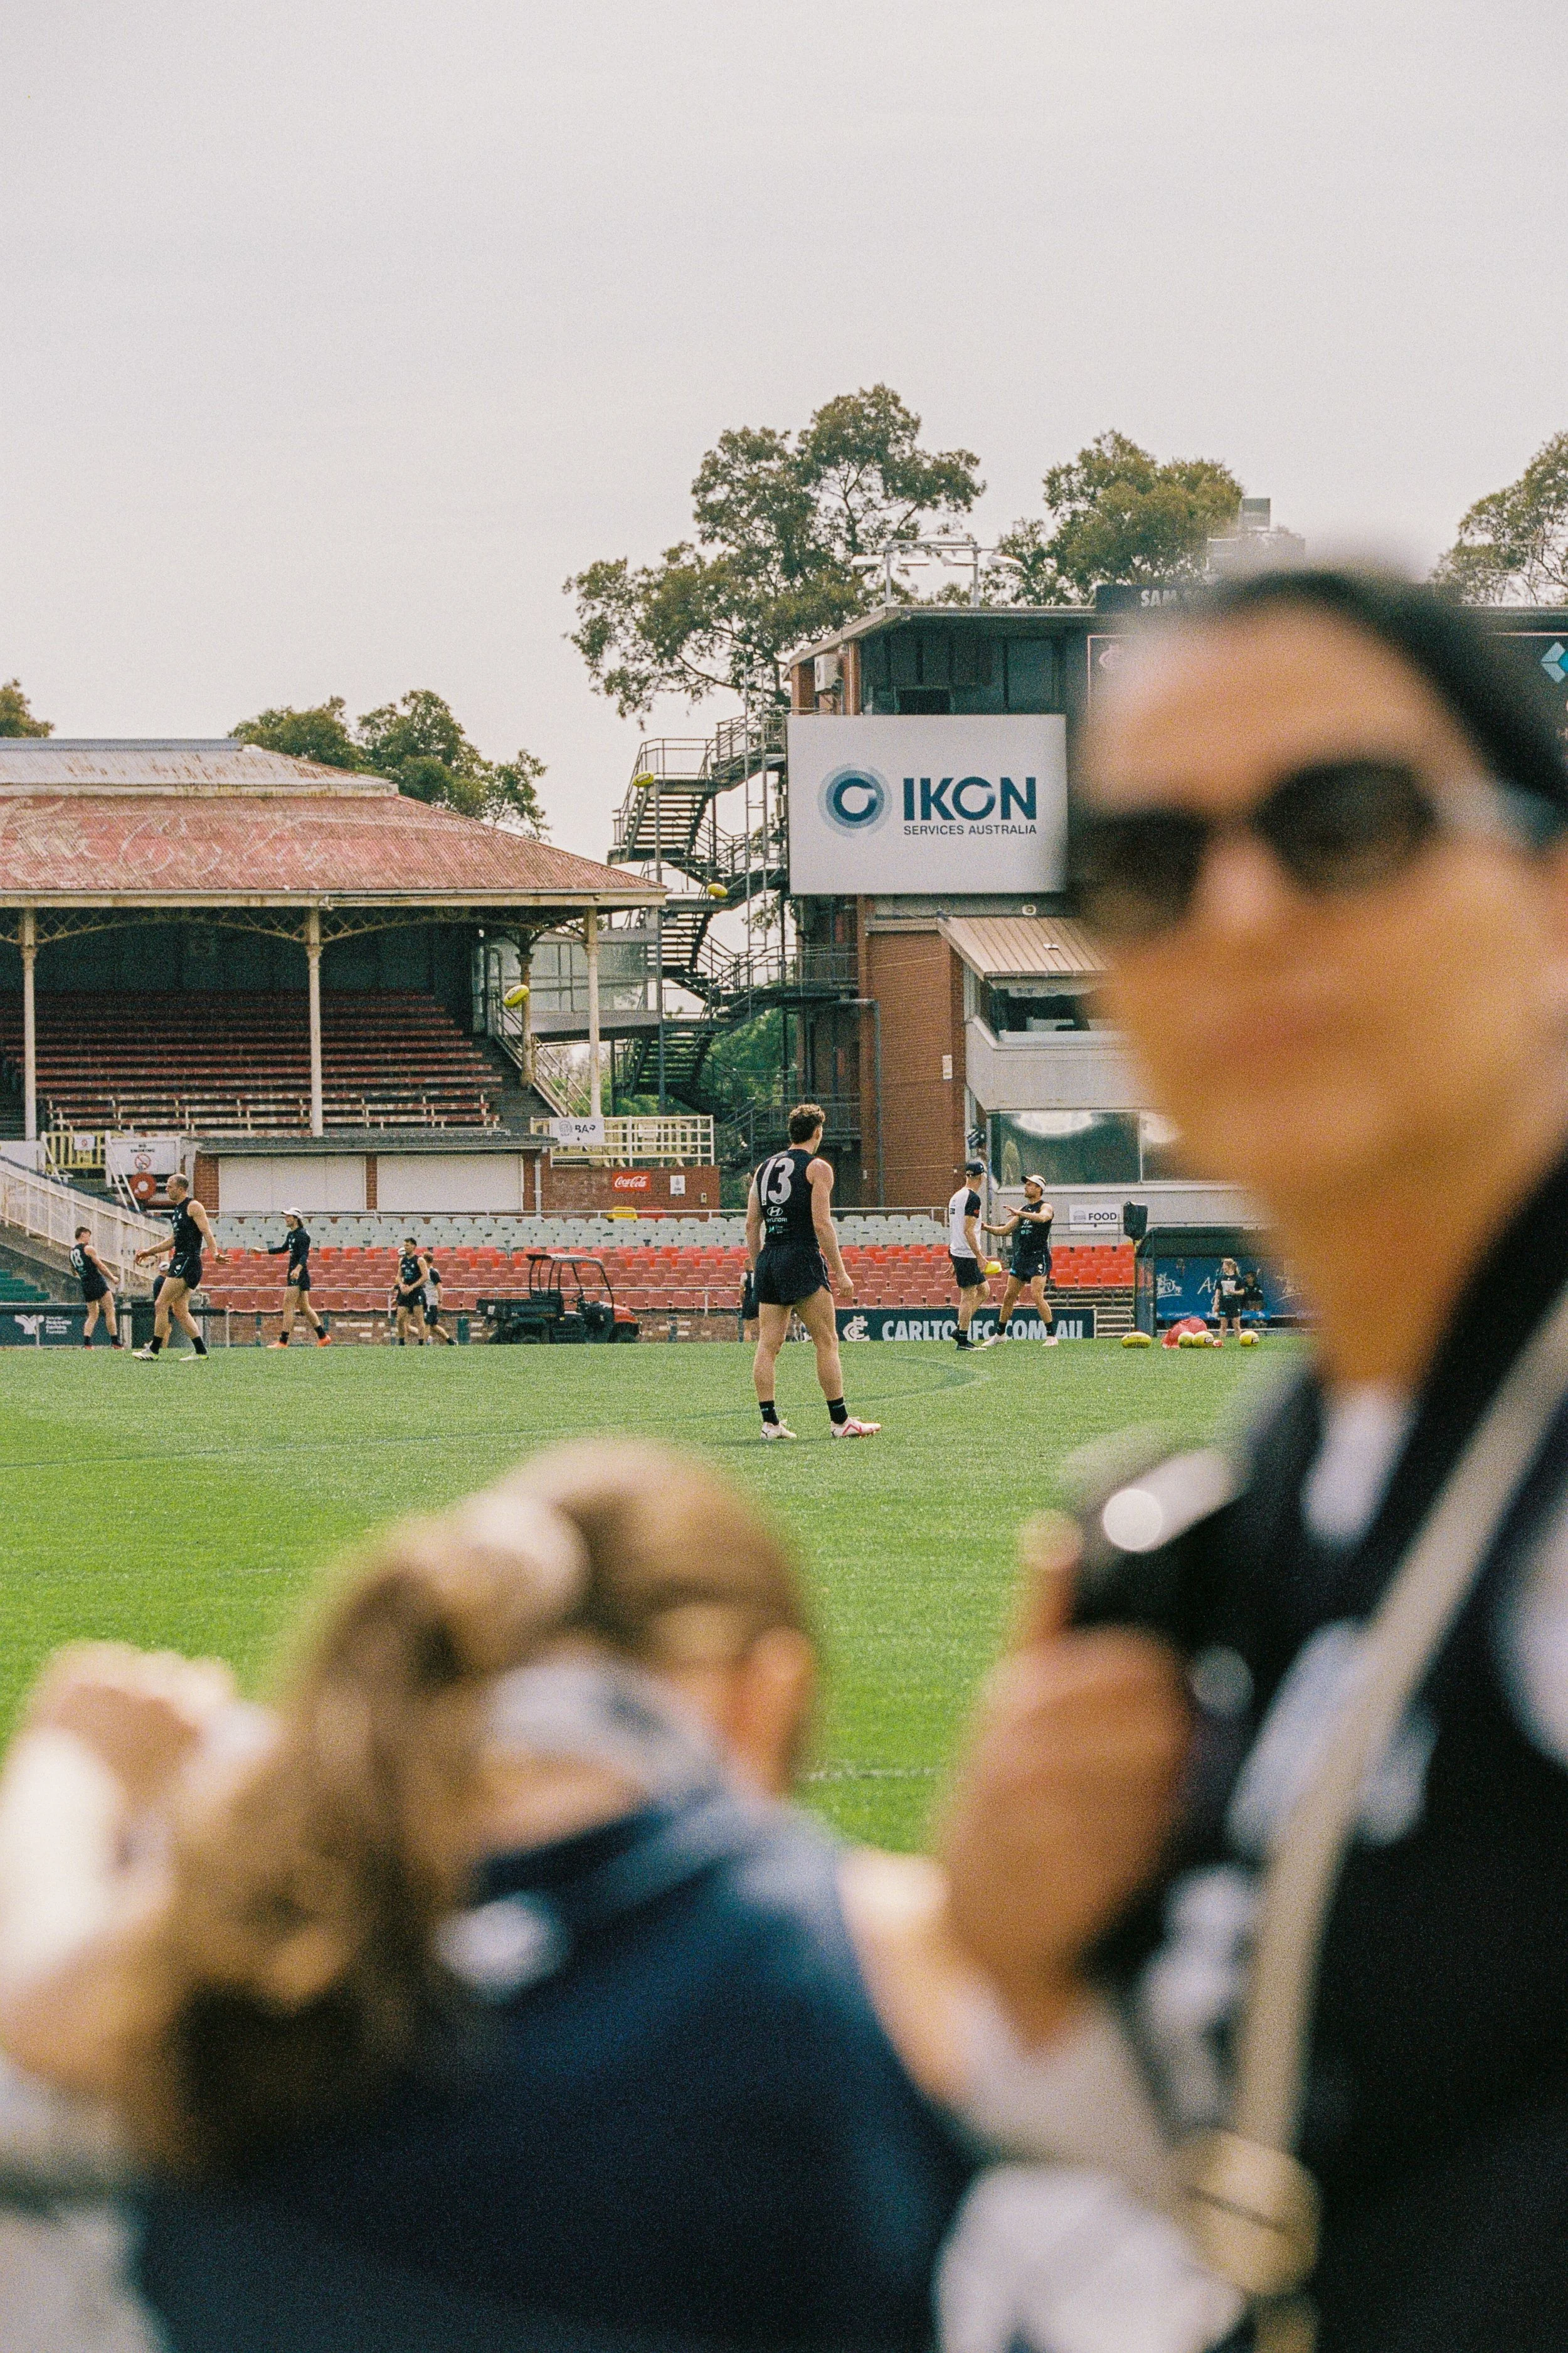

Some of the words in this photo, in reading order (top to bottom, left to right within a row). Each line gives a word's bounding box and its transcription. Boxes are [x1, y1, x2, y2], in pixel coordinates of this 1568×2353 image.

[903, 777, 1037, 821] IKON
[904, 825, 964, 835] SERVICES
[968, 824, 1037, 834] AUSTRALIA
[761, 1157, 795, 1205] 13
[1088, 1213, 1117, 1221] FOOD
